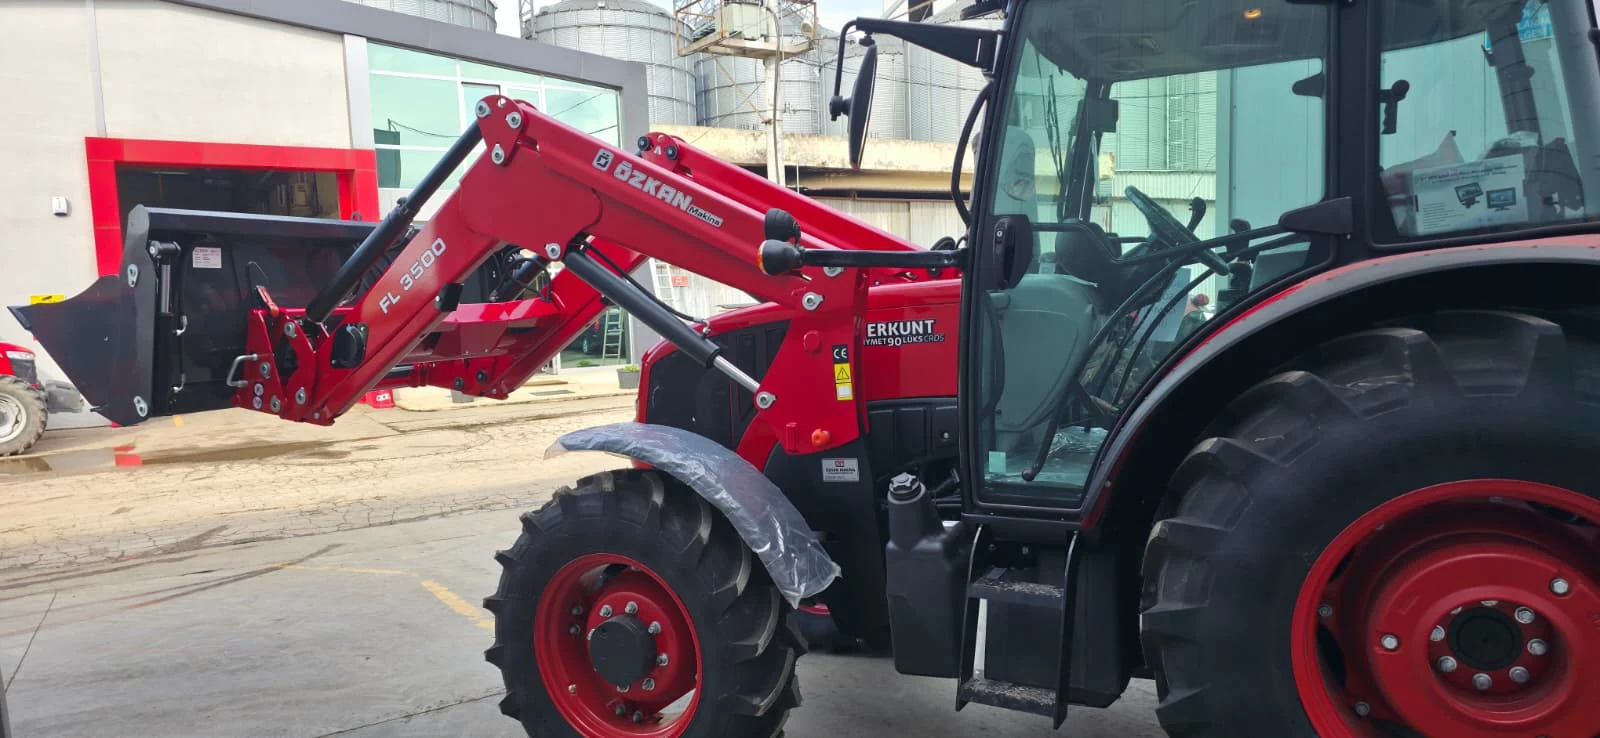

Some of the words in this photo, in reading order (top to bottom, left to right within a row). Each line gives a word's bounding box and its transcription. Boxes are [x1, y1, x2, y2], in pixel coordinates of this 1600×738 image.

[613, 161, 693, 212] ÖZKAN
[688, 206, 721, 226] Makina
[379, 292, 401, 315] FL
[400, 237, 447, 291] 3500
[867, 319, 935, 337] ERKUNT
[887, 337, 902, 347] 90
[902, 334, 923, 344] LÜKS
[833, 347, 848, 359] CE
